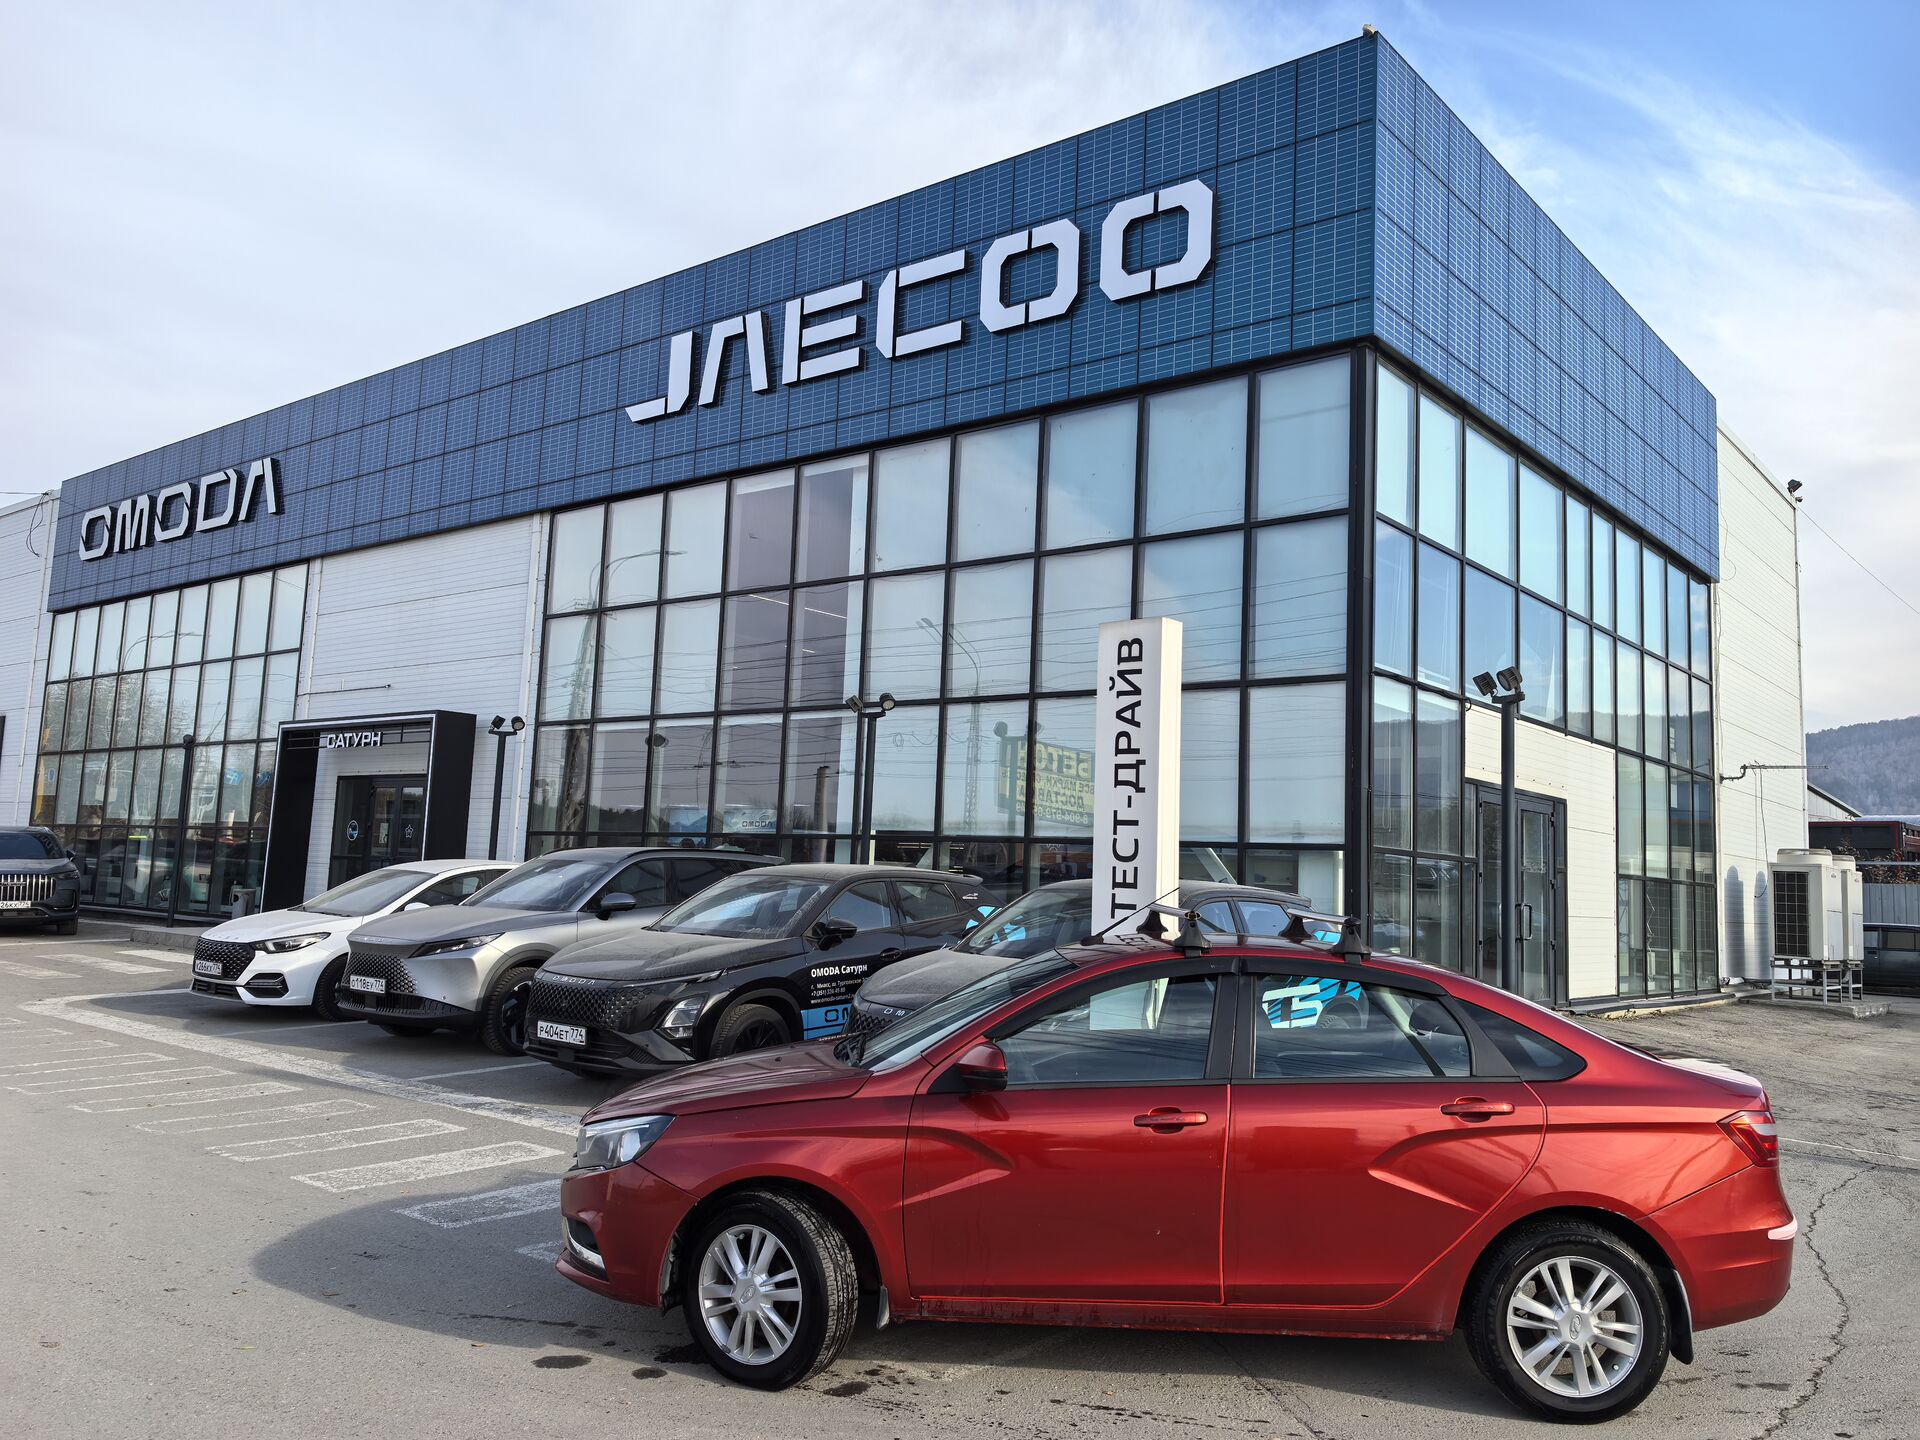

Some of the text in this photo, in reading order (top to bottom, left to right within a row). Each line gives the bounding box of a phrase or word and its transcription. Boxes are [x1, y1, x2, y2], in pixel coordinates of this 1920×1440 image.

[625, 179, 1214, 423] JAECOO
[79, 457, 277, 561] OMODA
[326, 731, 382, 748] САТУРН
[1109, 637, 1146, 919] ТЕСТ-ДРАЙВ
[811, 964, 867, 977] OMODA Сатурн
